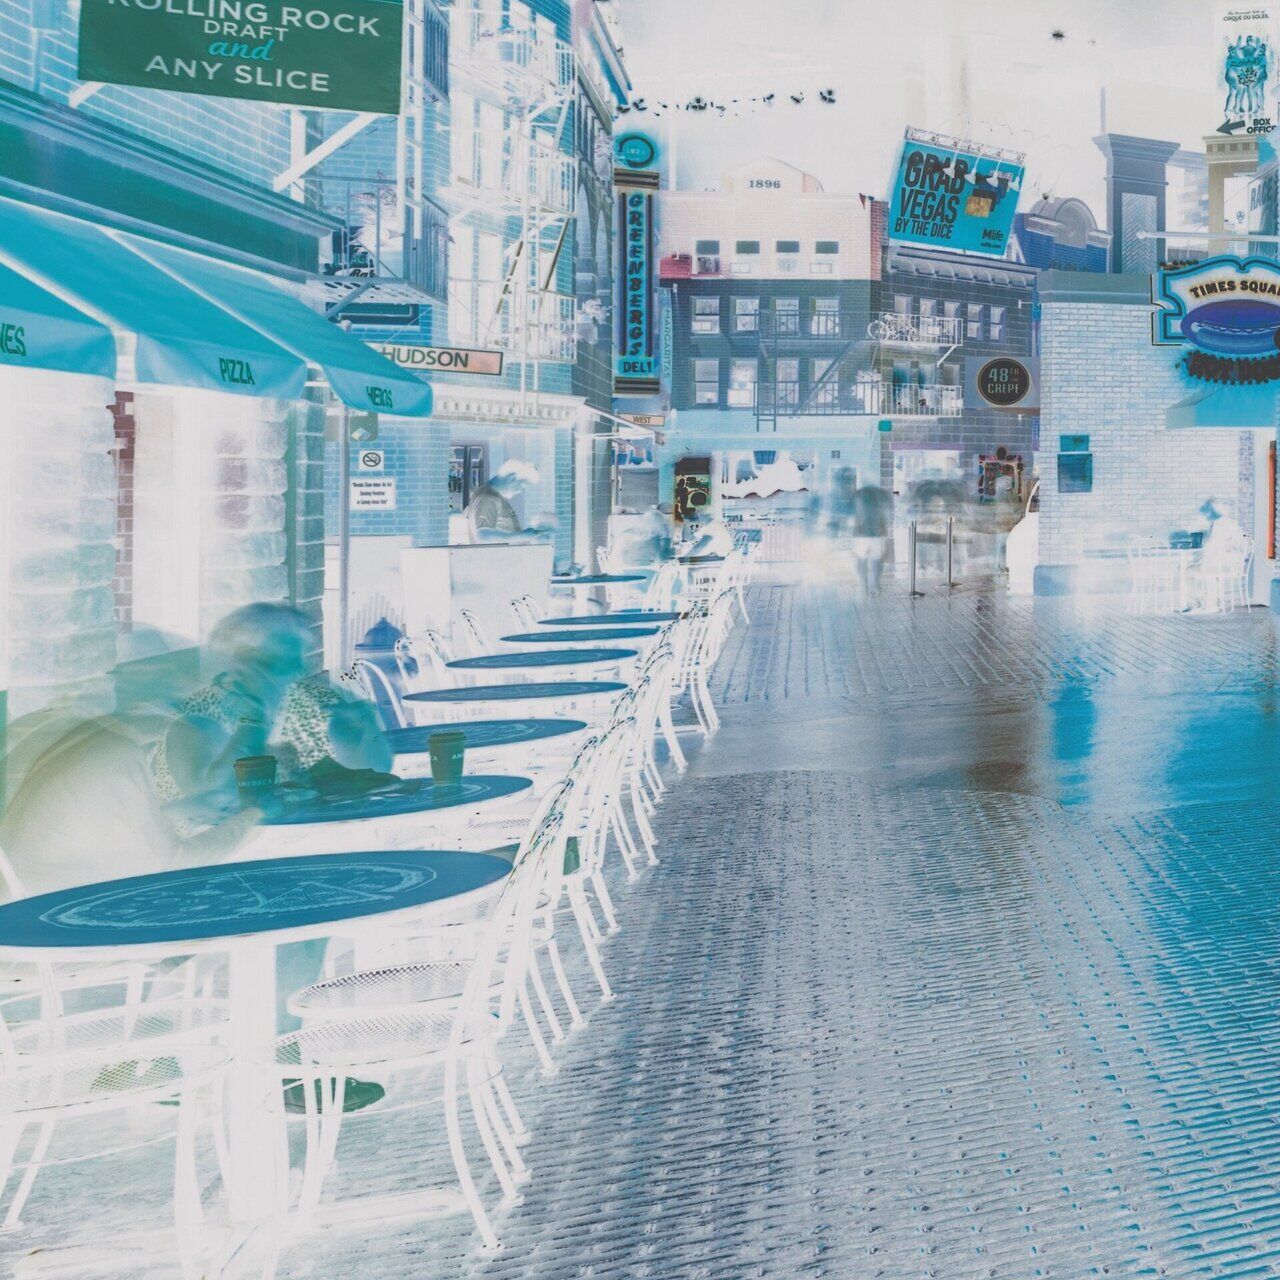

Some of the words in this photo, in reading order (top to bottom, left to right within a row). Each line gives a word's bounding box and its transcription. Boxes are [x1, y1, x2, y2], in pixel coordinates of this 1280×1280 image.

[282, 6, 379, 37] ROCK
[1223, 14, 1242, 22] CIRQUE
[204, 20, 288, 42] DRAFT
[208, 39, 274, 61] and
[145, 55, 223, 80] ANY
[234, 65, 330, 93] SLICE
[1253, 118, 1271, 126] BOX
[905, 150, 968, 195] GRAB
[748, 179, 781, 189] 1896
[900, 187, 960, 223] VEGAS
[895, 217, 910, 233] BY
[910, 219, 929, 236] THE
[930, 222, 954, 239] DICE
[1189, 280, 1237, 298] TIMES
[382, 347, 469, 368] HUDSON
[623, 360, 652, 373] DELI
[219, 357, 256, 386] PIZZA
[633, 416, 651, 424] WEST
